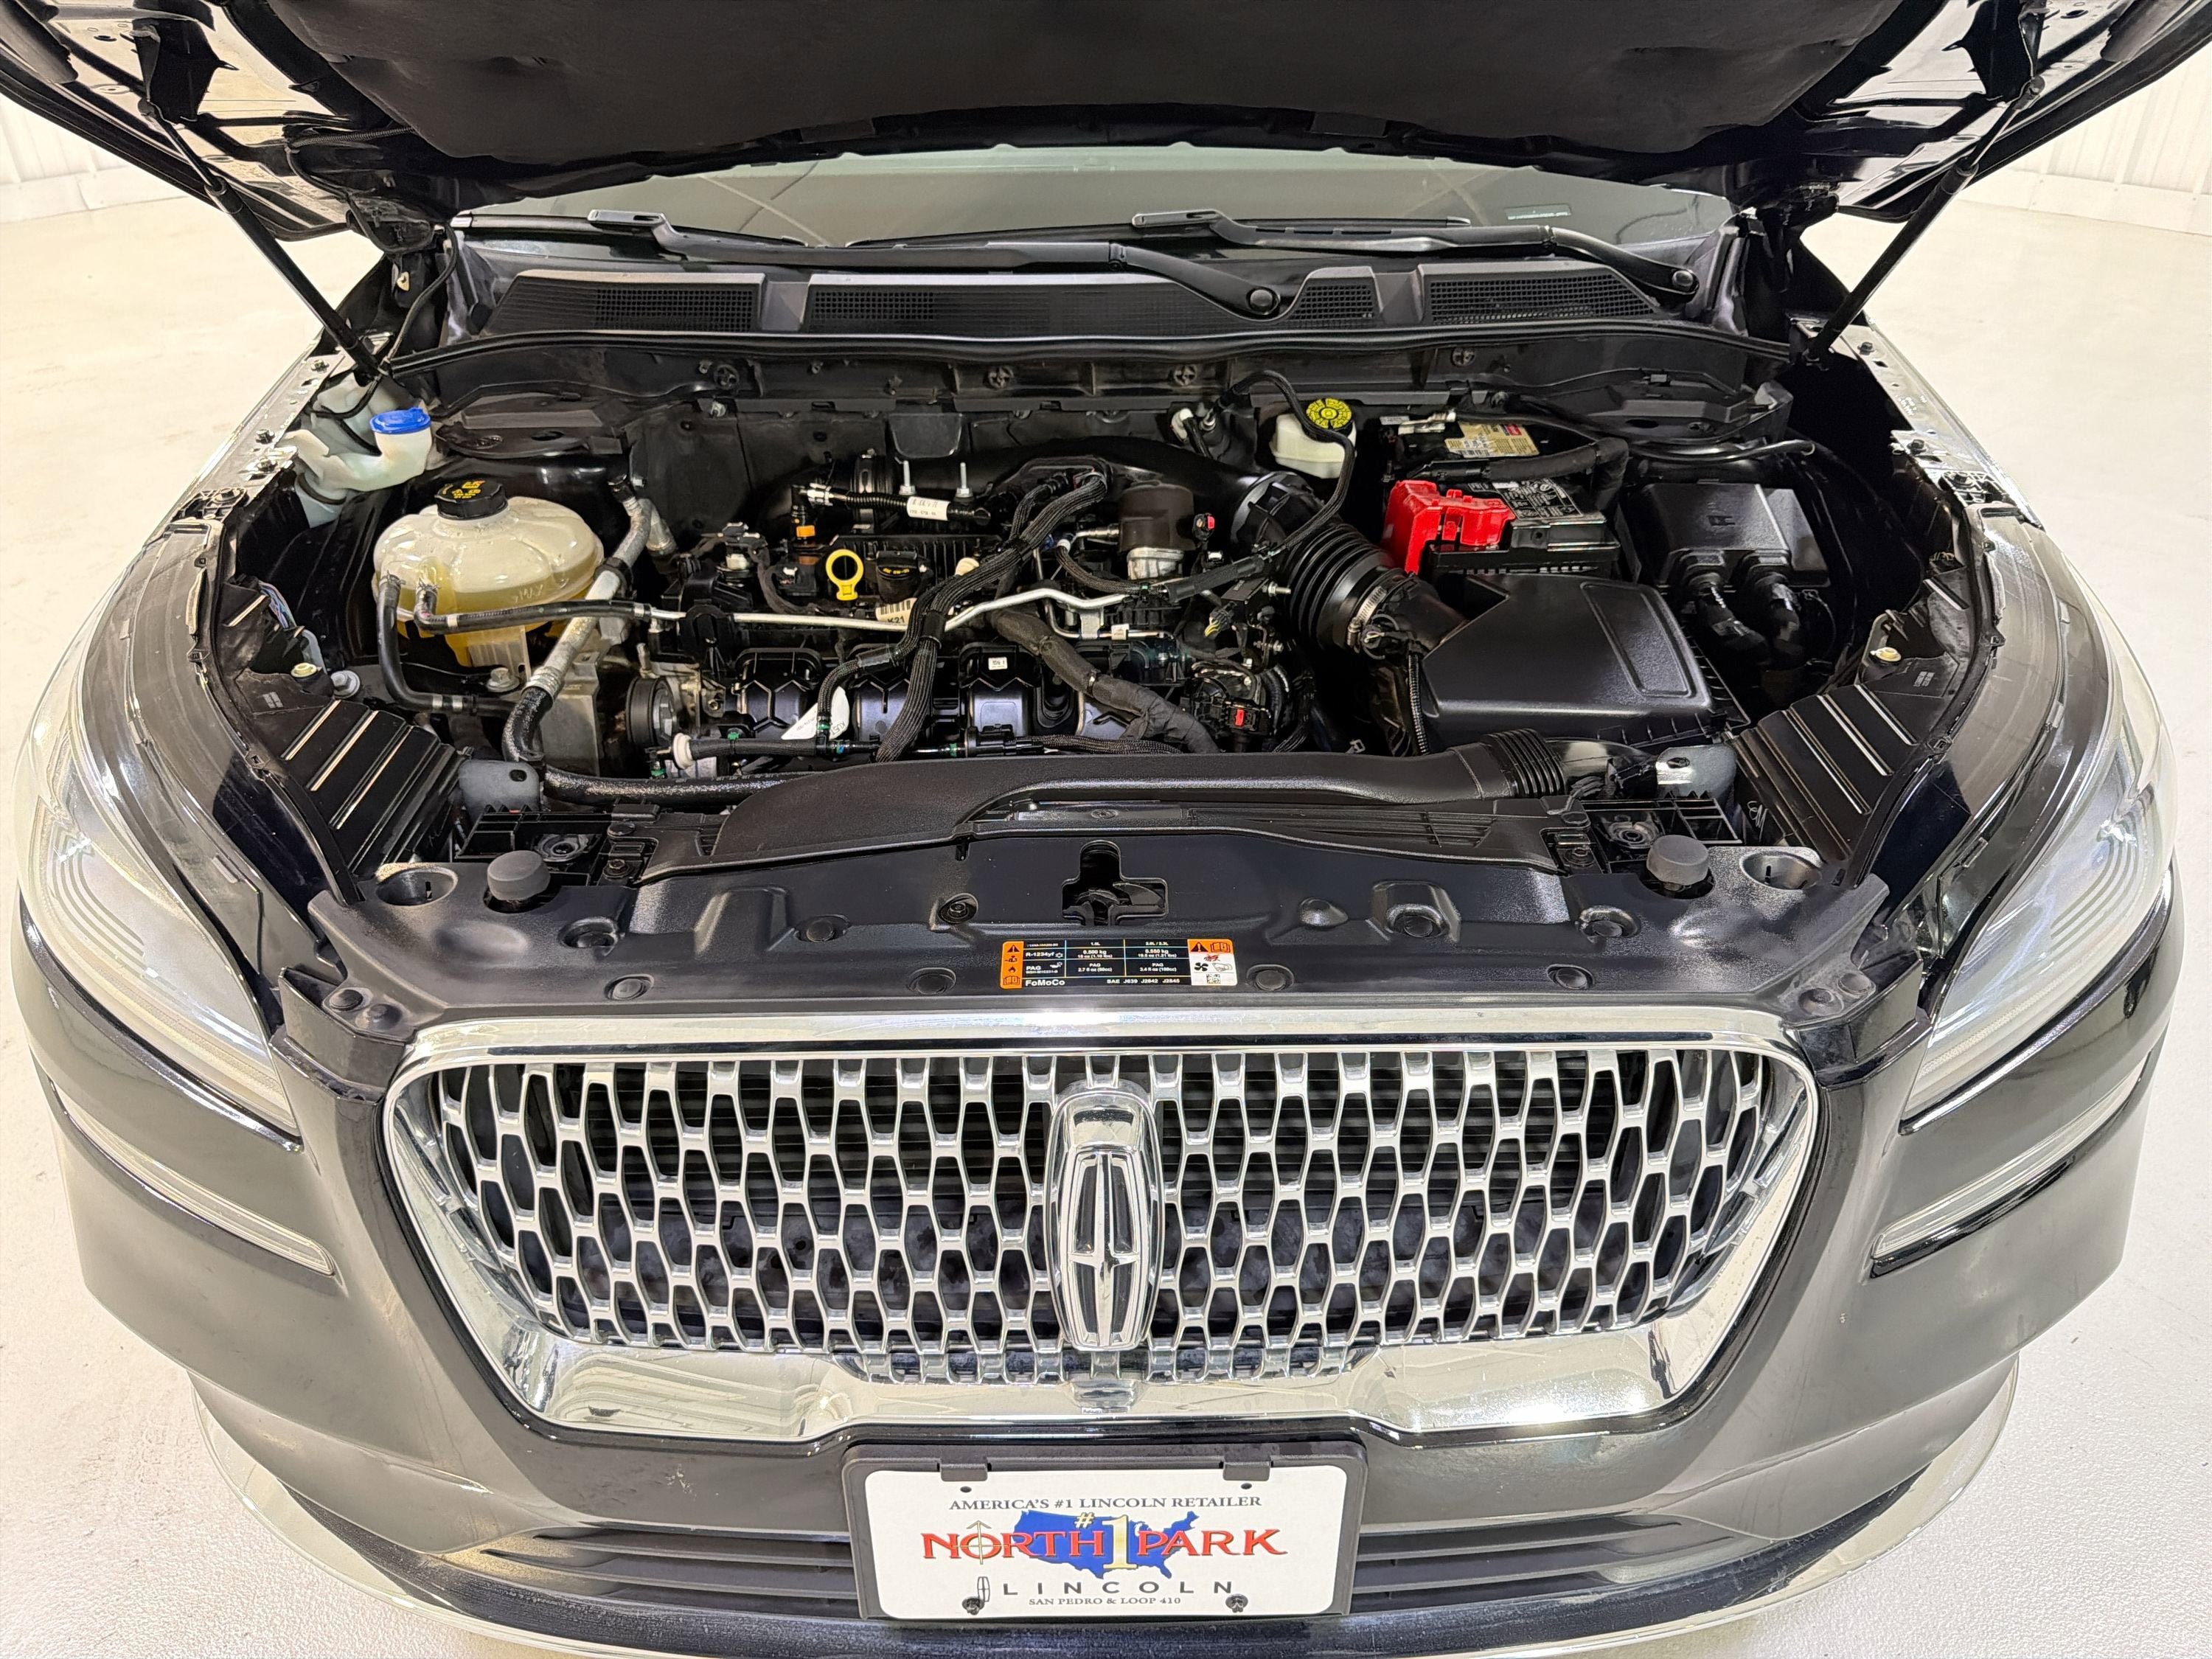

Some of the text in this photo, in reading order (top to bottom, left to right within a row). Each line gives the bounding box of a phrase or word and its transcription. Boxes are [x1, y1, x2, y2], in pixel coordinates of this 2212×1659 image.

[950, 1496, 1262, 1509] AMERICA'S #1 LINCOLN RETAILER
[920, 1530, 1104, 1559] NORTH
[1137, 1528, 1288, 1557] PARK
[1004, 1581, 1231, 1596] LINCOLN
[1057, 1597, 1103, 1605] PEDRO
